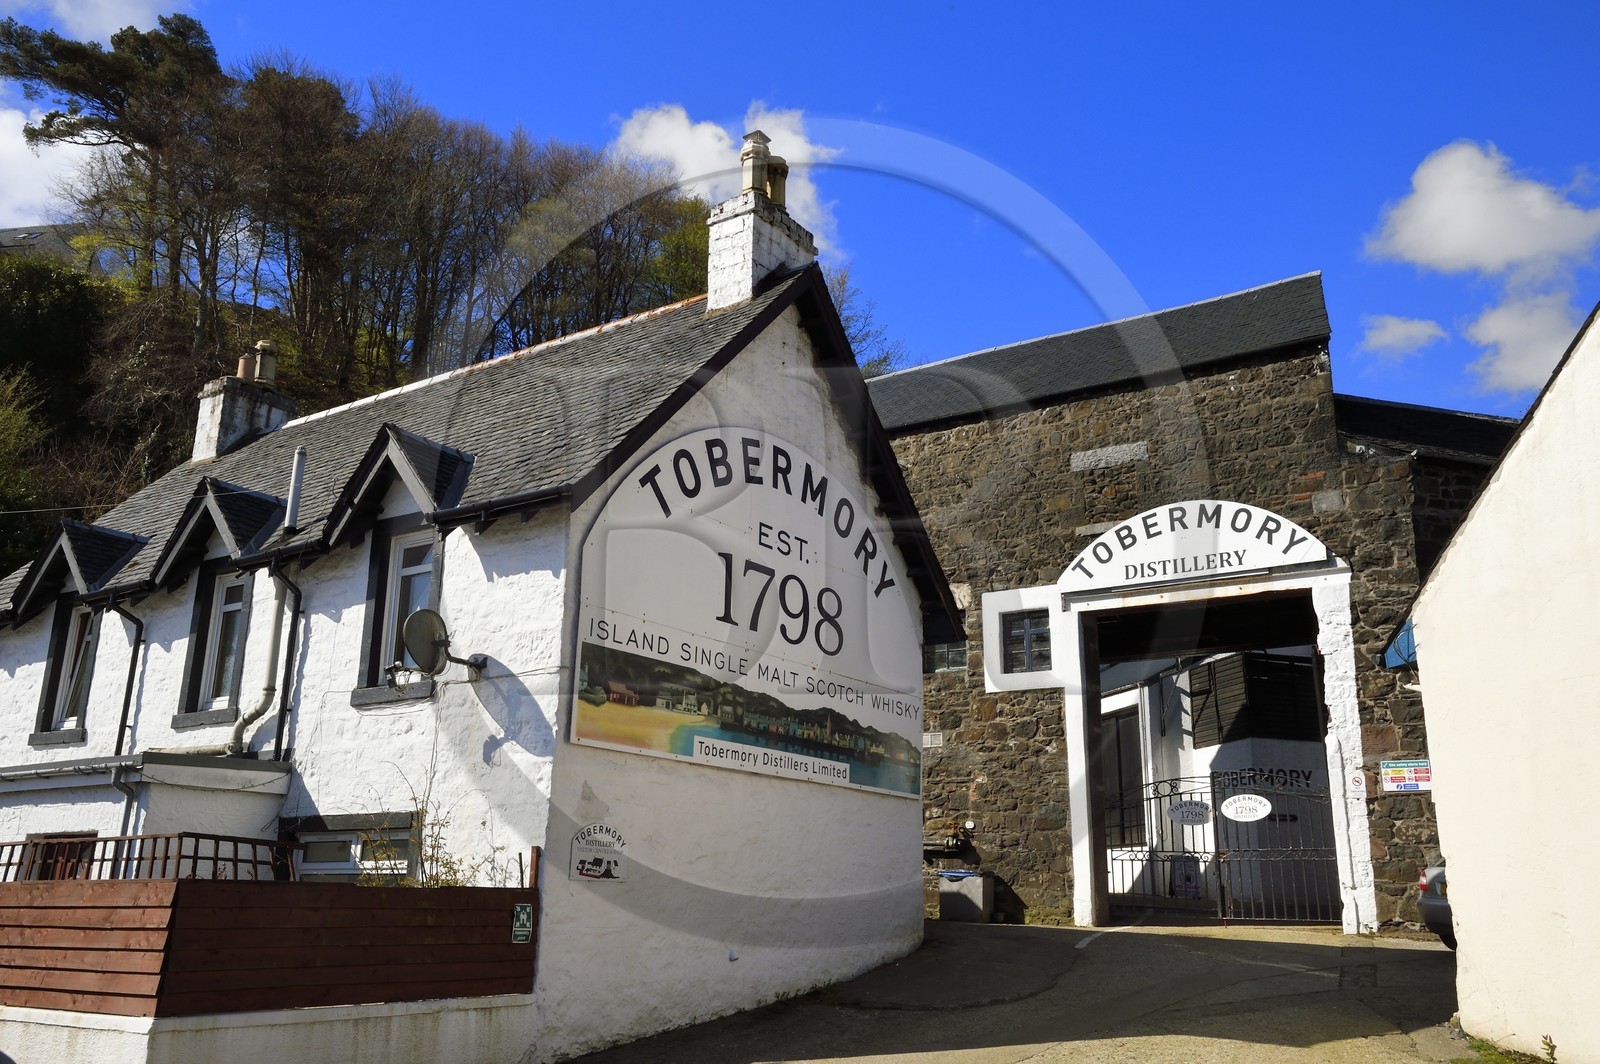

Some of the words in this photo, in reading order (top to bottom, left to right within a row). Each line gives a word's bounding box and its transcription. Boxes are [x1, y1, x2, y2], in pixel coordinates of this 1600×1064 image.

[638, 437, 896, 599] TOBERMORY
[758, 522, 810, 564] EST.
[1071, 503, 1309, 581] TOBERMORY
[1124, 549, 1247, 581] DISTILLERY
[715, 551, 843, 657] 1798
[589, 617, 670, 656] ISLAND
[680, 642, 748, 676] SINGLE
[758, 664, 799, 689] MALT
[806, 676, 864, 706] SCOTCH
[870, 693, 920, 721] WHISKY
[698, 741, 758, 767] Tobermory
[762, 751, 809, 774] Distillers
[812, 760, 848, 780] Limited
[1171, 801, 1211, 813] TOBERMORY
[1180, 810, 1205, 819] 1798
[1225, 796, 1267, 809] TOBERMORY
[1234, 805, 1258, 815] 1798
[575, 825, 627, 848] TOBERMORY
[585, 839, 615, 848] DISTILLERY
